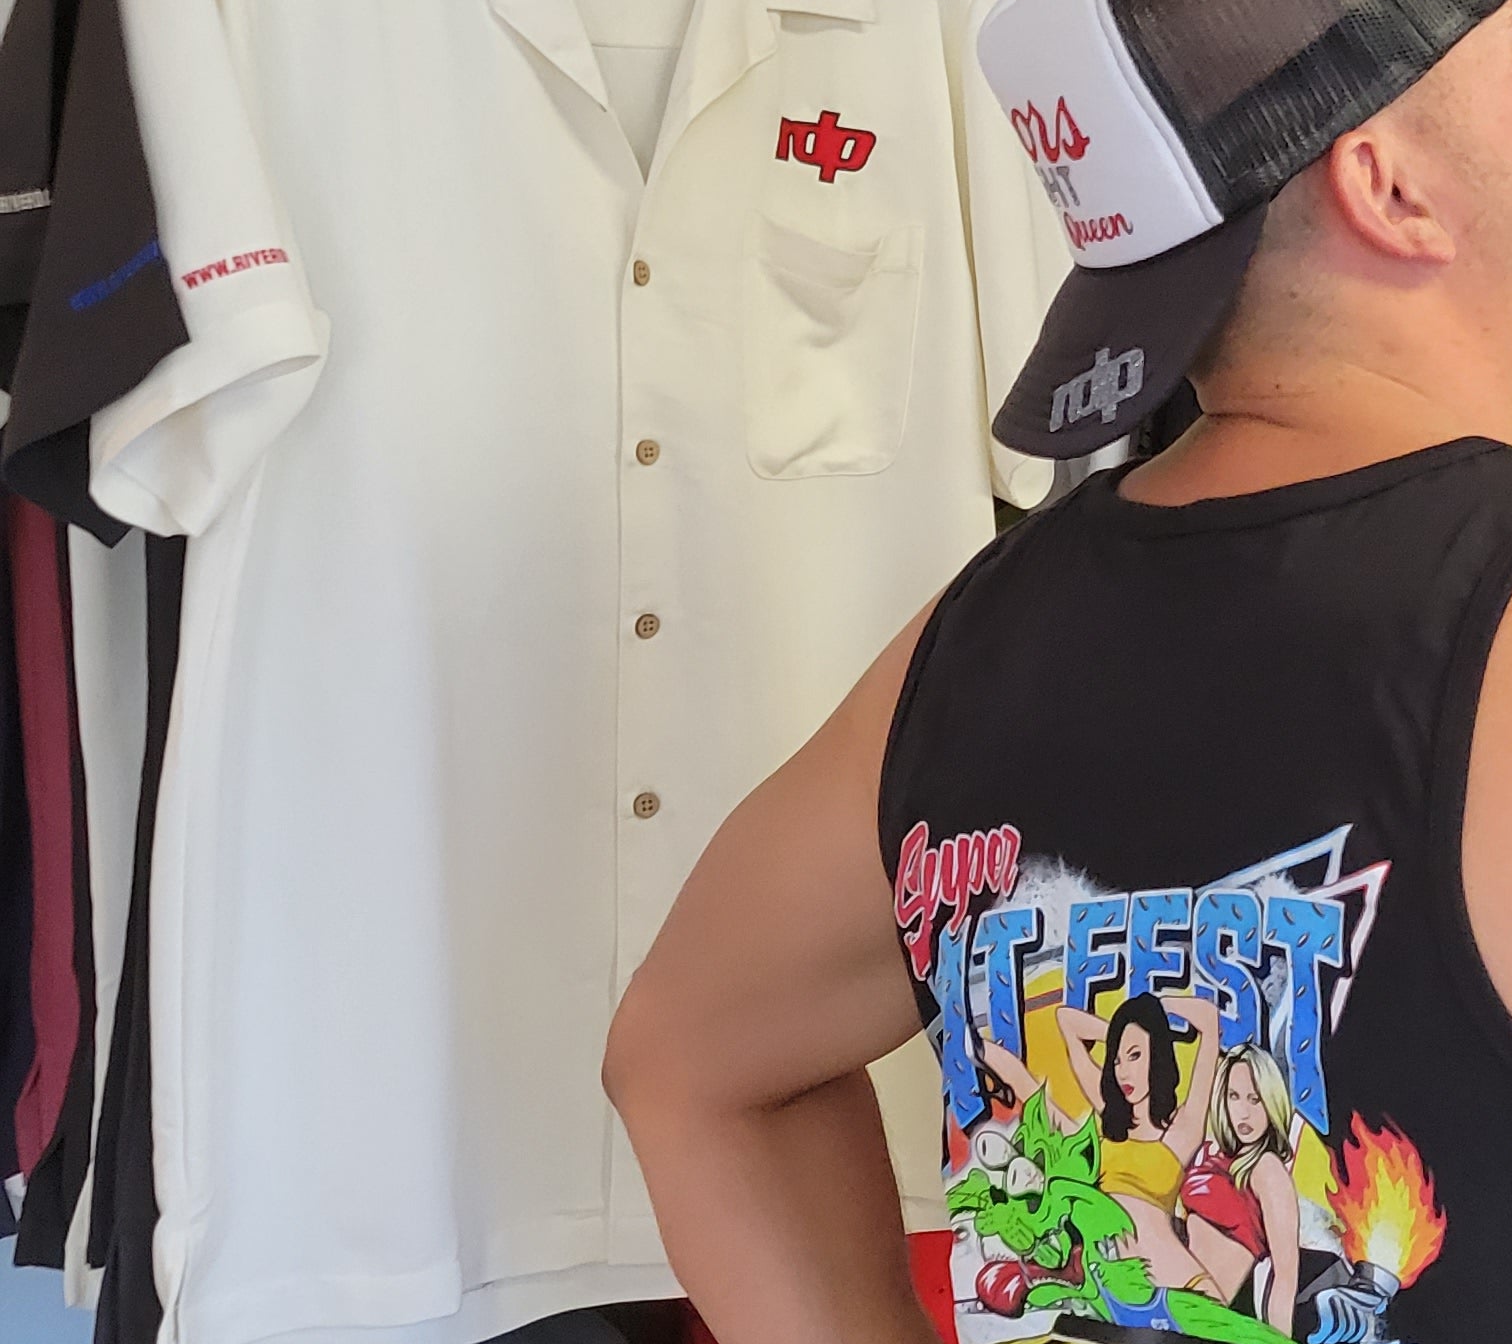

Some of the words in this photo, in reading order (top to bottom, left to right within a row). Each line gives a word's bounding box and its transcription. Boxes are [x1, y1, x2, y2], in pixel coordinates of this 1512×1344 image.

[775, 109, 877, 184] rdp
[1049, 347, 1144, 433] rdp
[1063, 887, 1345, 1135] FEST
